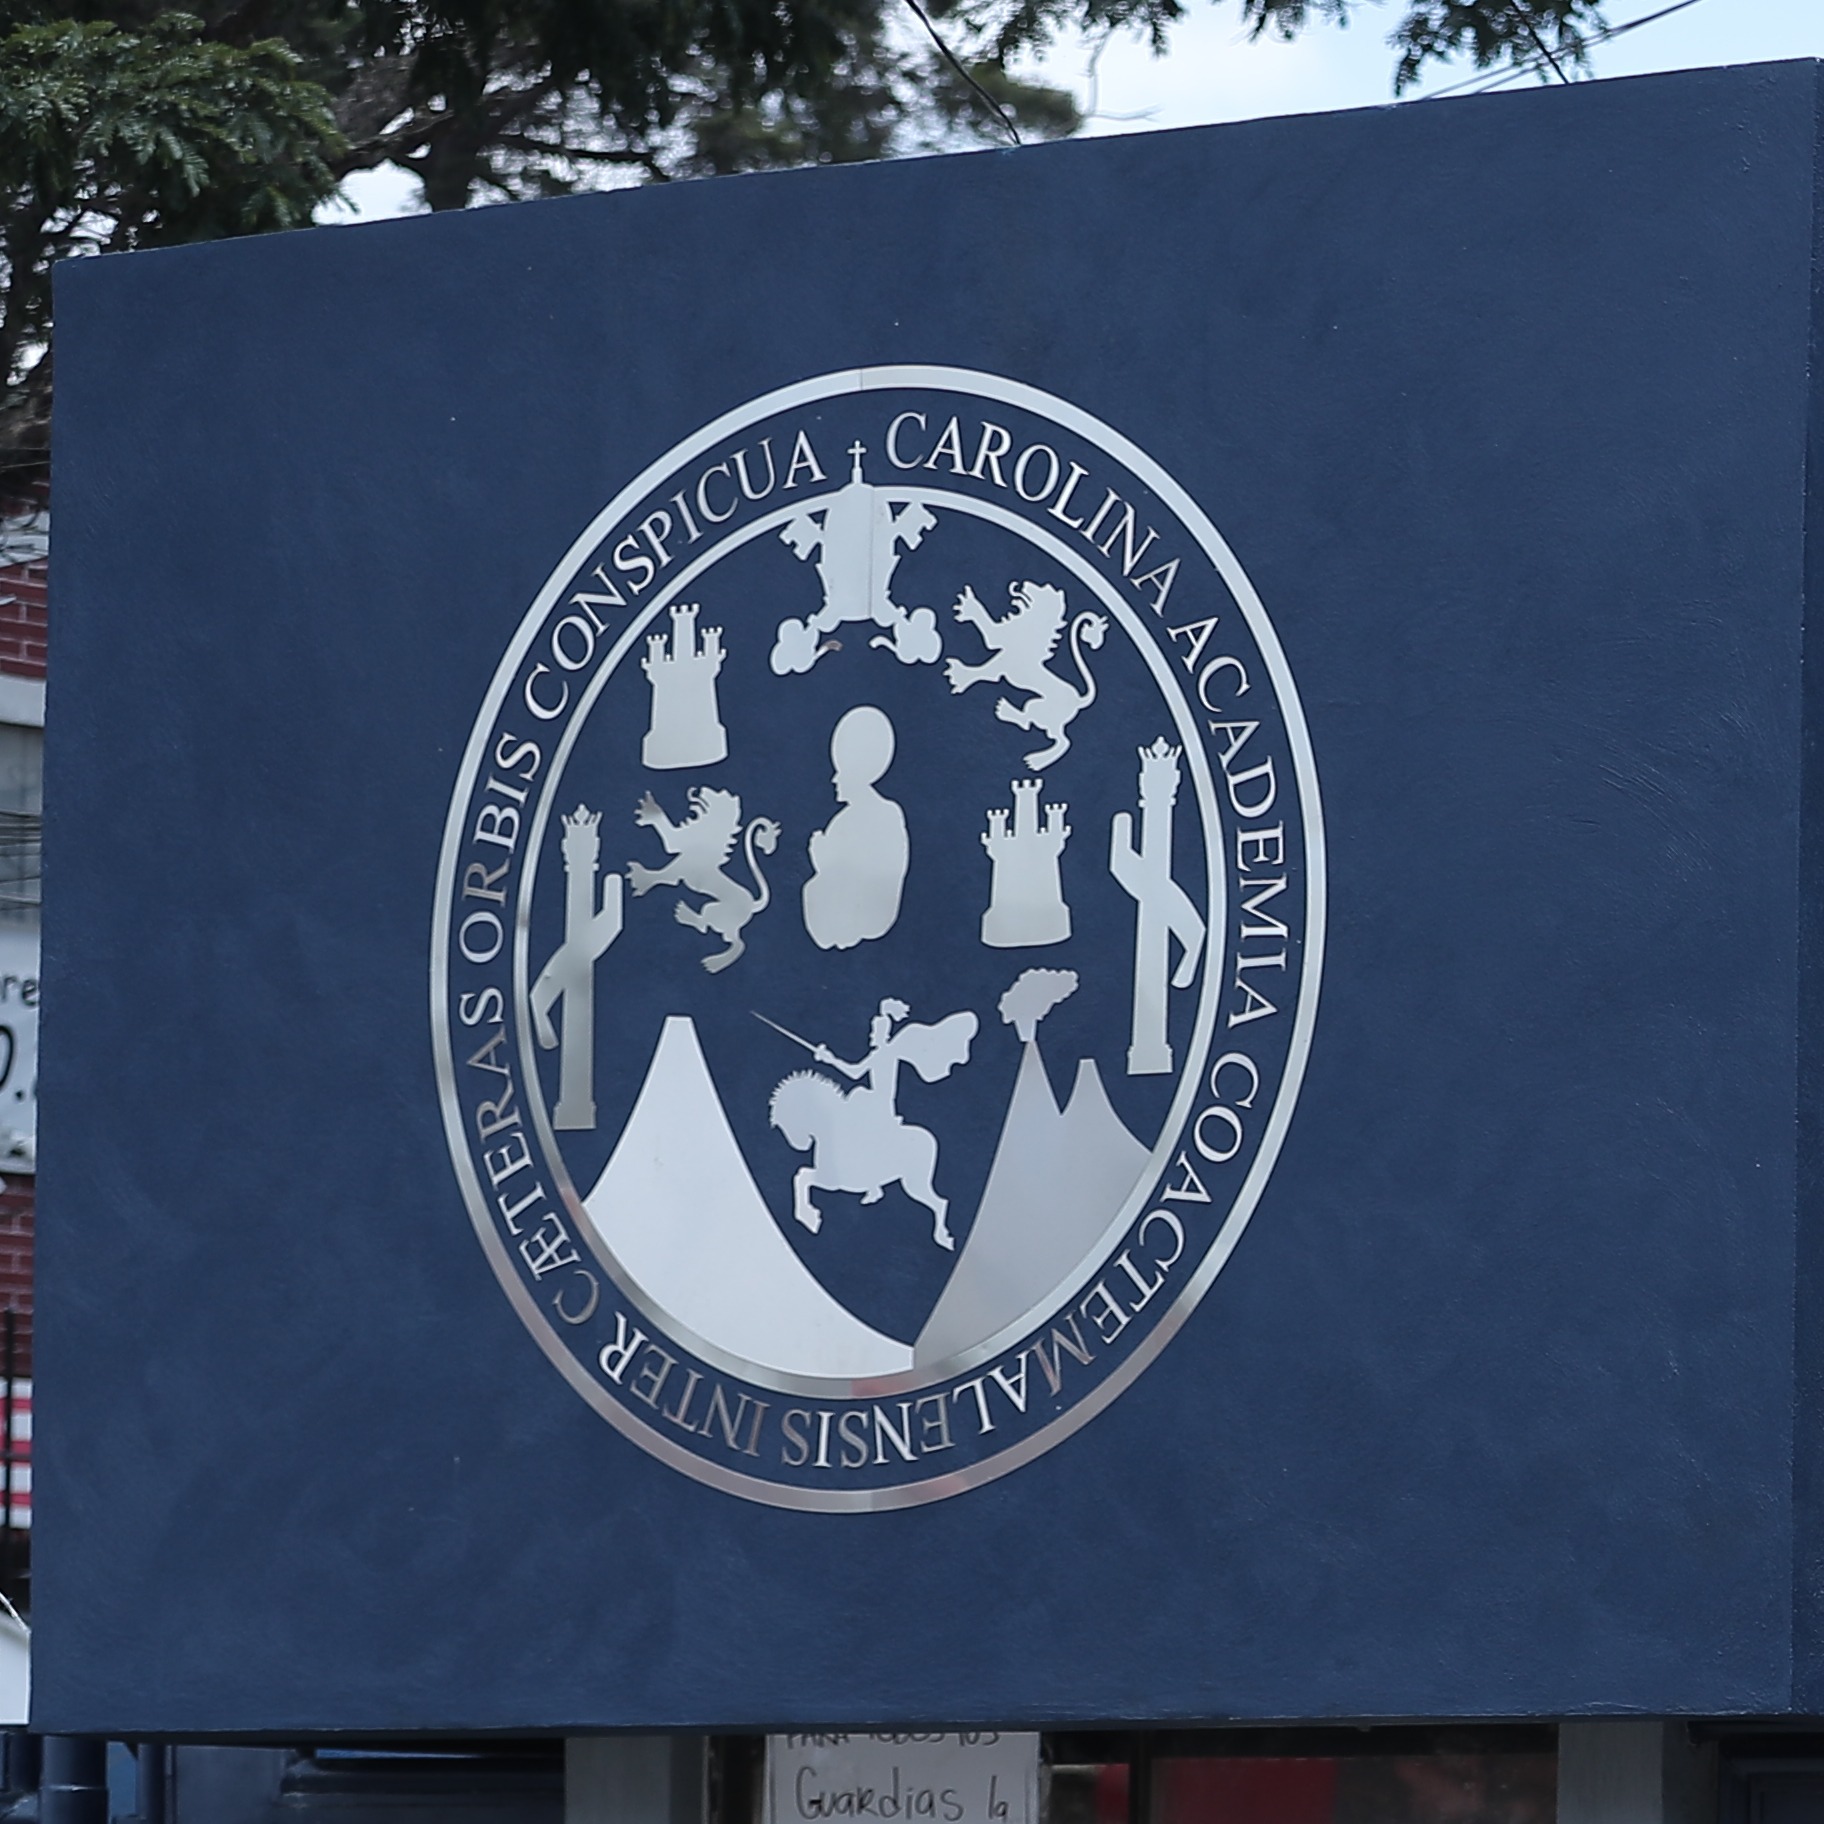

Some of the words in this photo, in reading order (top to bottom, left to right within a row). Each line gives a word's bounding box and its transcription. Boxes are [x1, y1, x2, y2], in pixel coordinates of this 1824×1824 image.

[524, 430, 826, 722] CONSPICUA
[886, 411, 1182, 614] CAROLINA
[459, 732, 543, 963] ORBIS
[1167, 614, 1288, 1027] ACADEMIA
[600, 1311, 767, 1433] INTER
[781, 1049, 1263, 1469] COACTEMALENSIS
[987, 1775, 1010, 1821] la
